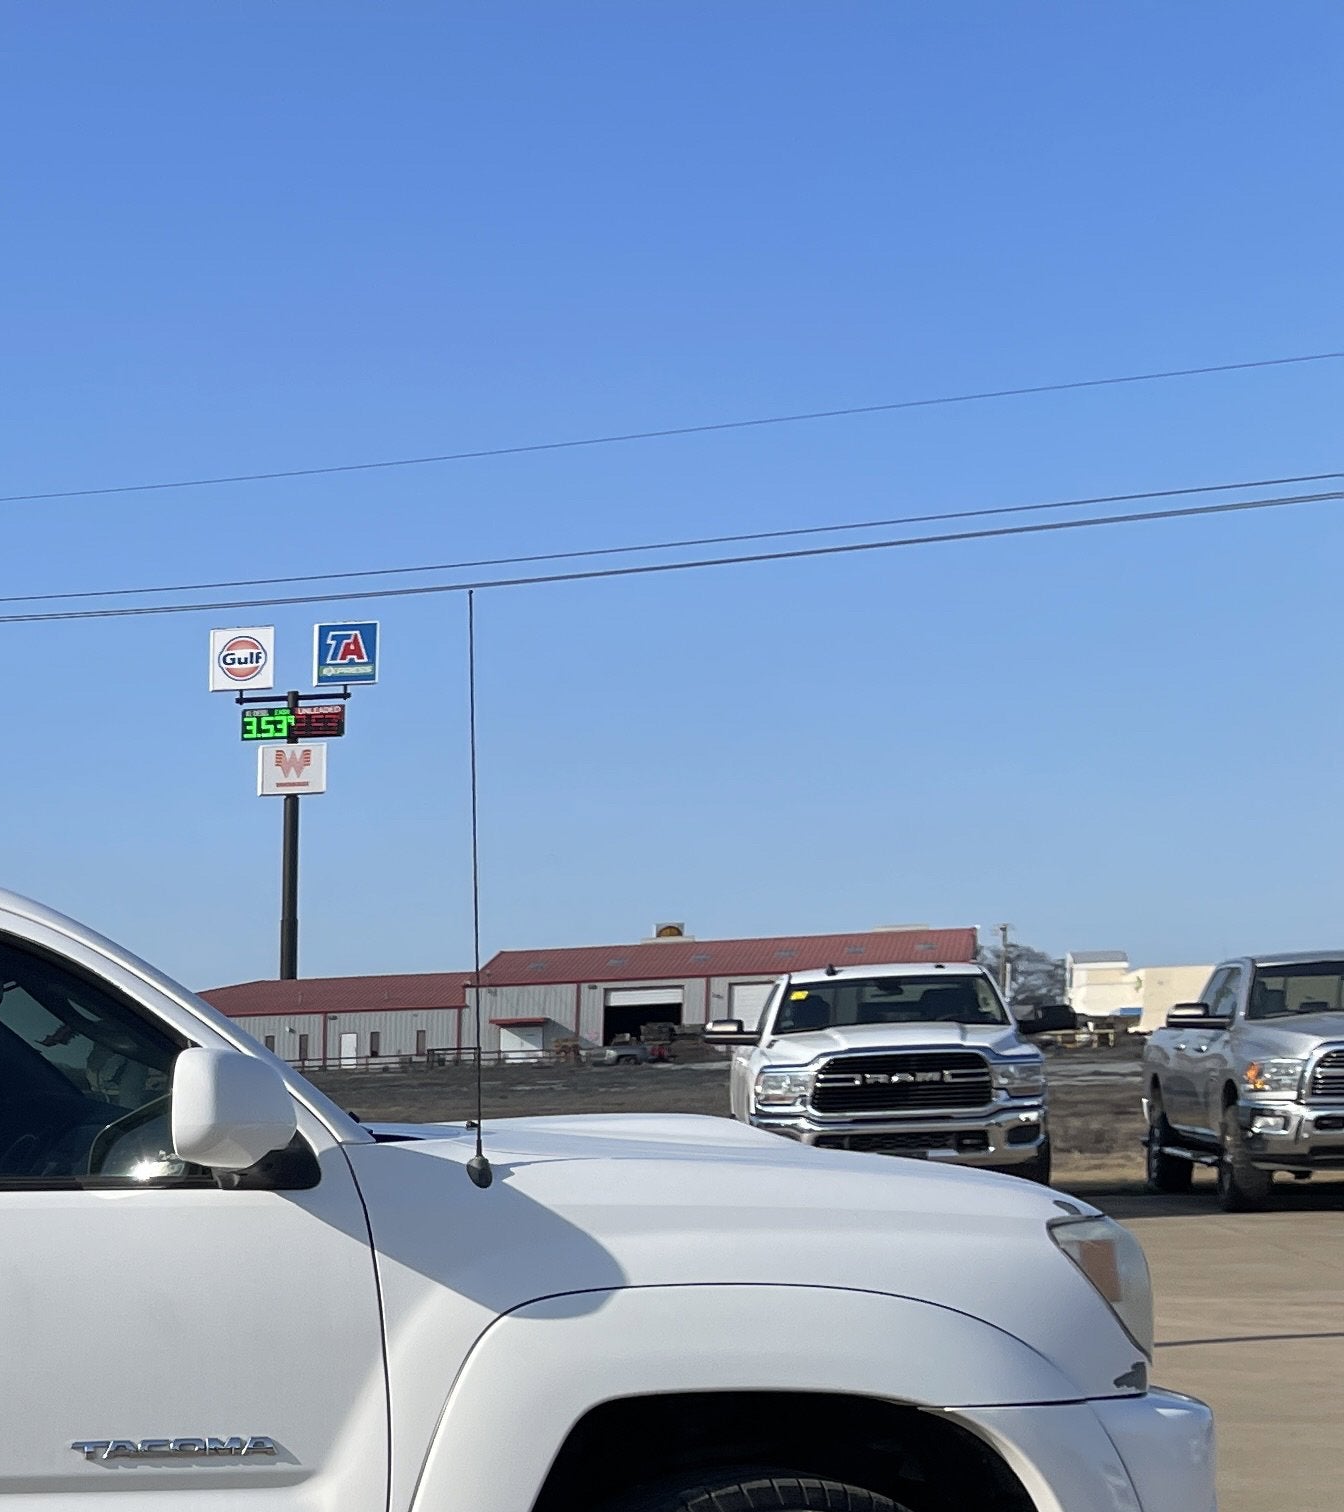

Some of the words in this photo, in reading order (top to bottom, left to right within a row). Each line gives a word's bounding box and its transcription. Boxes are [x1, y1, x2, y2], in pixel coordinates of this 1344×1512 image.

[222, 651, 262, 666] Gulf
[326, 631, 368, 664] TA
[70, 1436, 278, 1460] TACOMA
